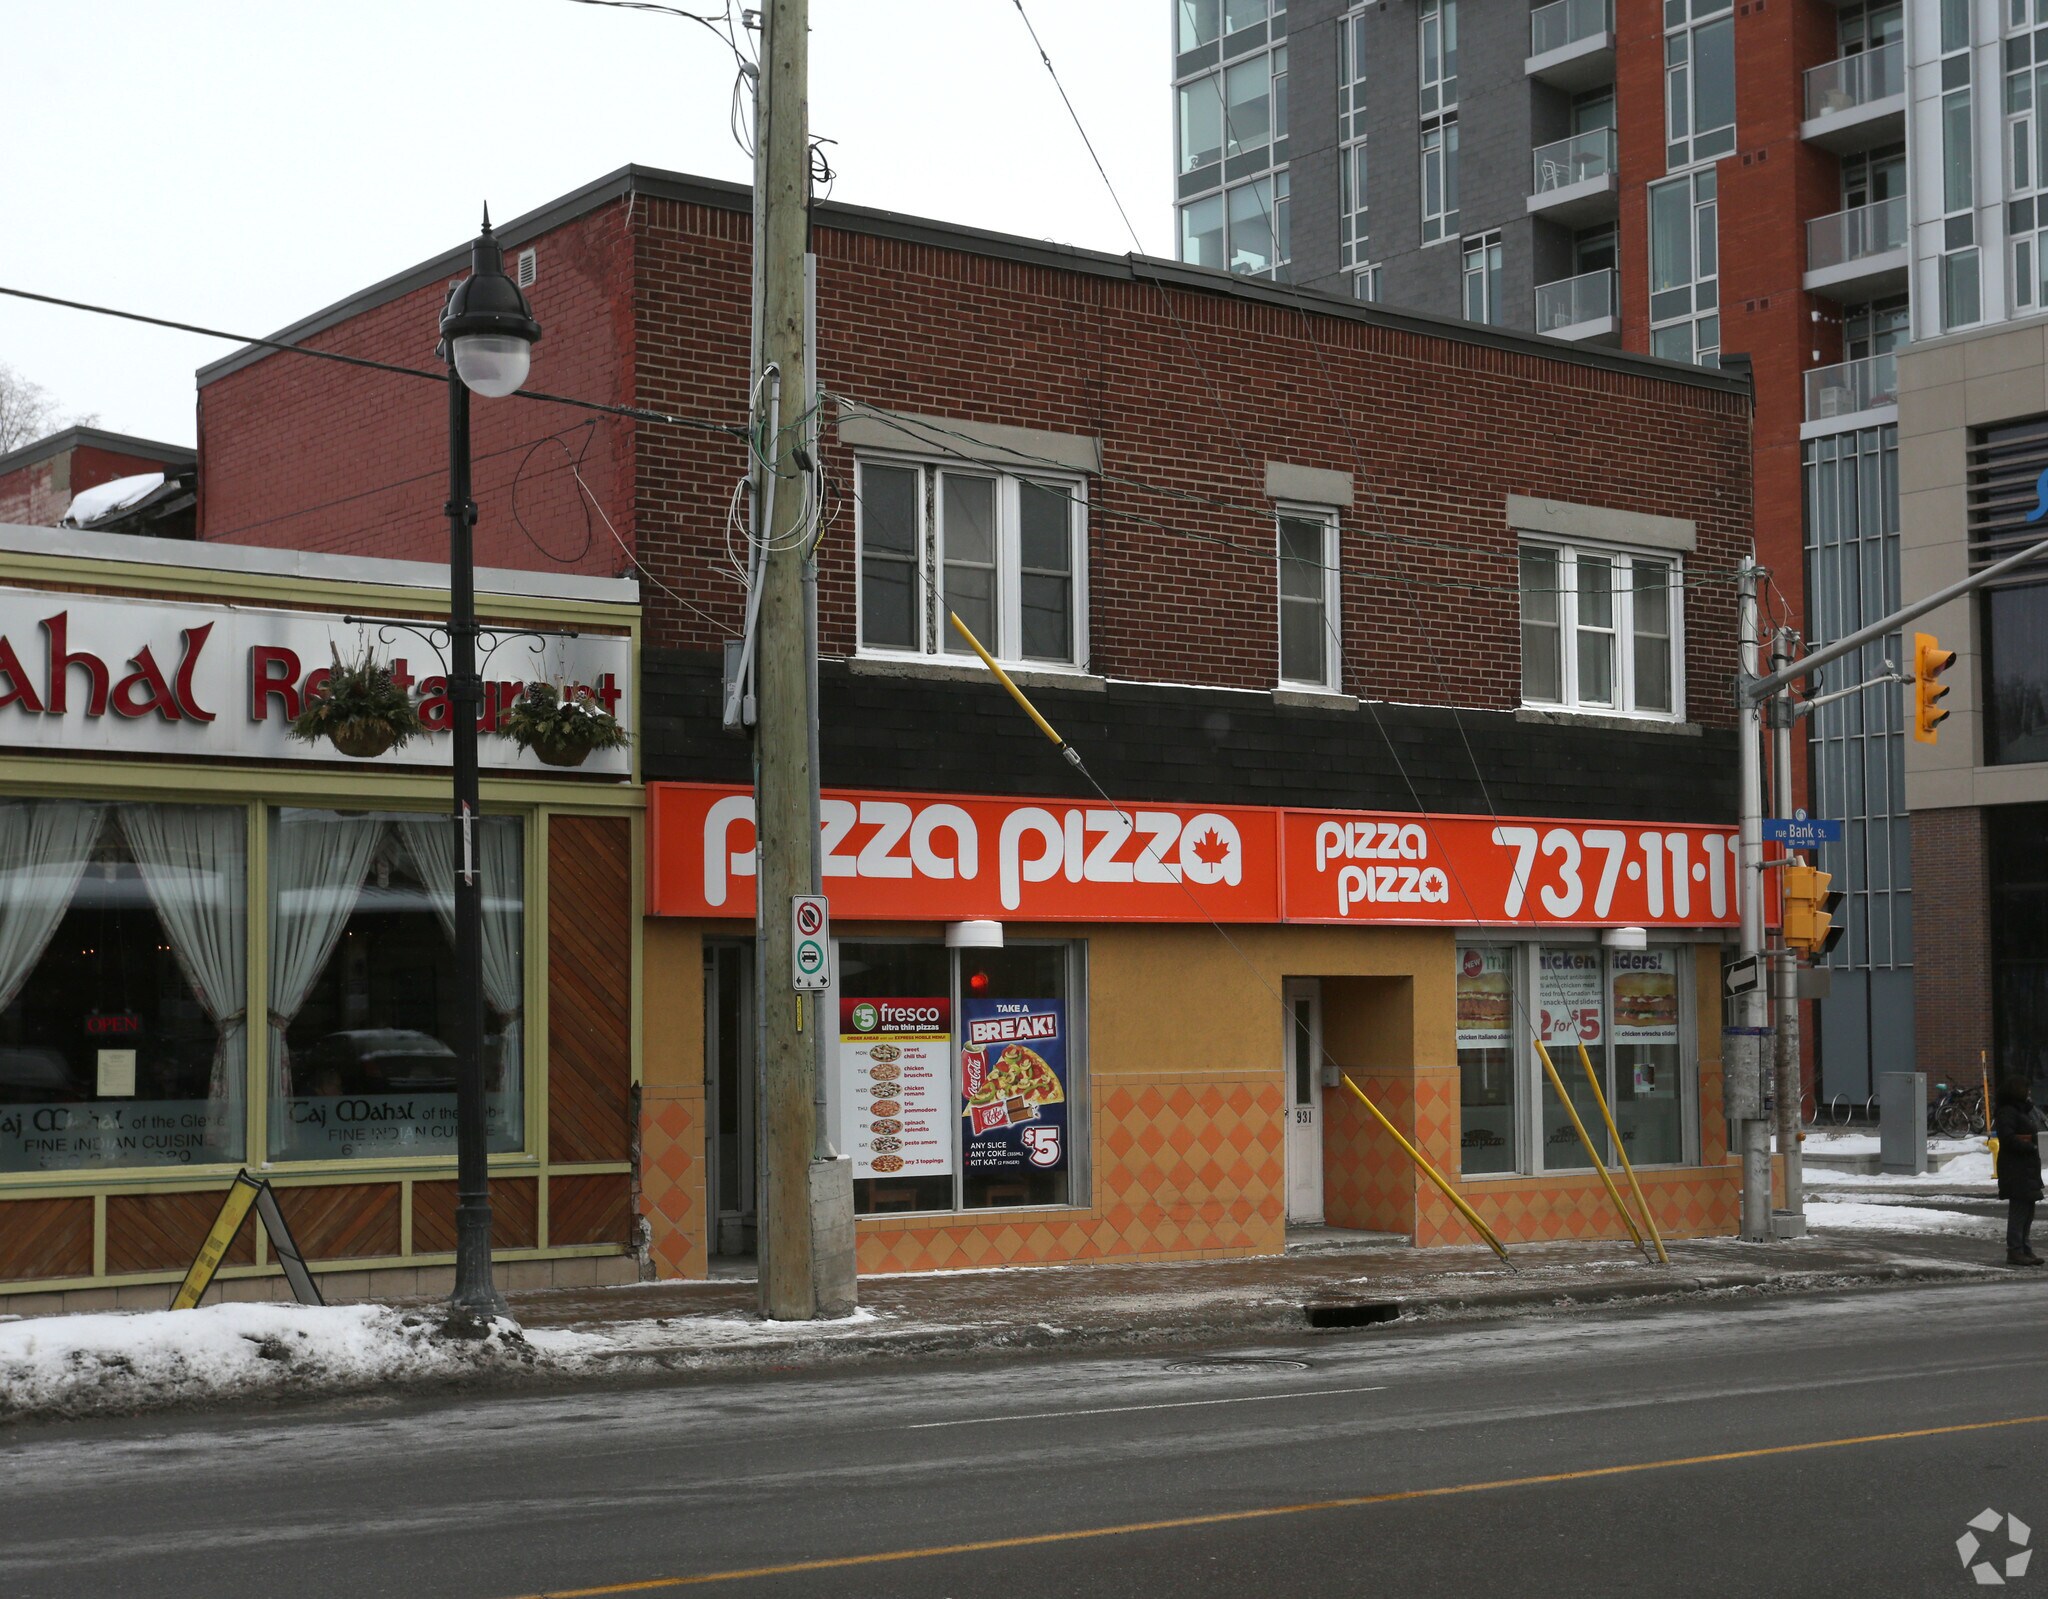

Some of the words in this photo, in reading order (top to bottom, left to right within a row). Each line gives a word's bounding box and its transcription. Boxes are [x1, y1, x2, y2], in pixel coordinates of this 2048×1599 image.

[1775, 829, 1787, 838] rue
[1789, 823, 1814, 838] Bank
[1817, 828, 1827, 838] St.
[704, 796, 978, 907] pzza
[1001, 807, 1242, 911] pizza
[1316, 821, 1427, 872] pizza
[1338, 866, 1449, 917] pizza
[1464, 959, 1480, 970] NEW
[880, 1003, 940, 1022] fresco
[996, 1004, 1020, 1013] TAKE
[1021, 1004, 1029, 1013] A
[87, 1016, 138, 1033] OPEN
[900, 1023, 914, 1031] thin
[916, 1023, 940, 1031] pizzas
[972, 1016, 1054, 1042] BREAK!
[1553, 1018, 1572, 1032] for
[288, 1101, 326, 1129] Taj
[336, 1100, 415, 1123] Mahal
[422, 1107, 437, 1120] of
[1296, 1110, 1312, 1124] 931
[0, 1109, 22, 1139] aj
[132, 1113, 147, 1130] of
[152, 1114, 176, 1129] the
[328, 1128, 366, 1141] FINE
[24, 1138, 67, 1153] FINE
[970, 1142, 986, 1150] ANY
[987, 1141, 1007, 1149] SLICE
[1024, 1127, 1060, 1166] $5
